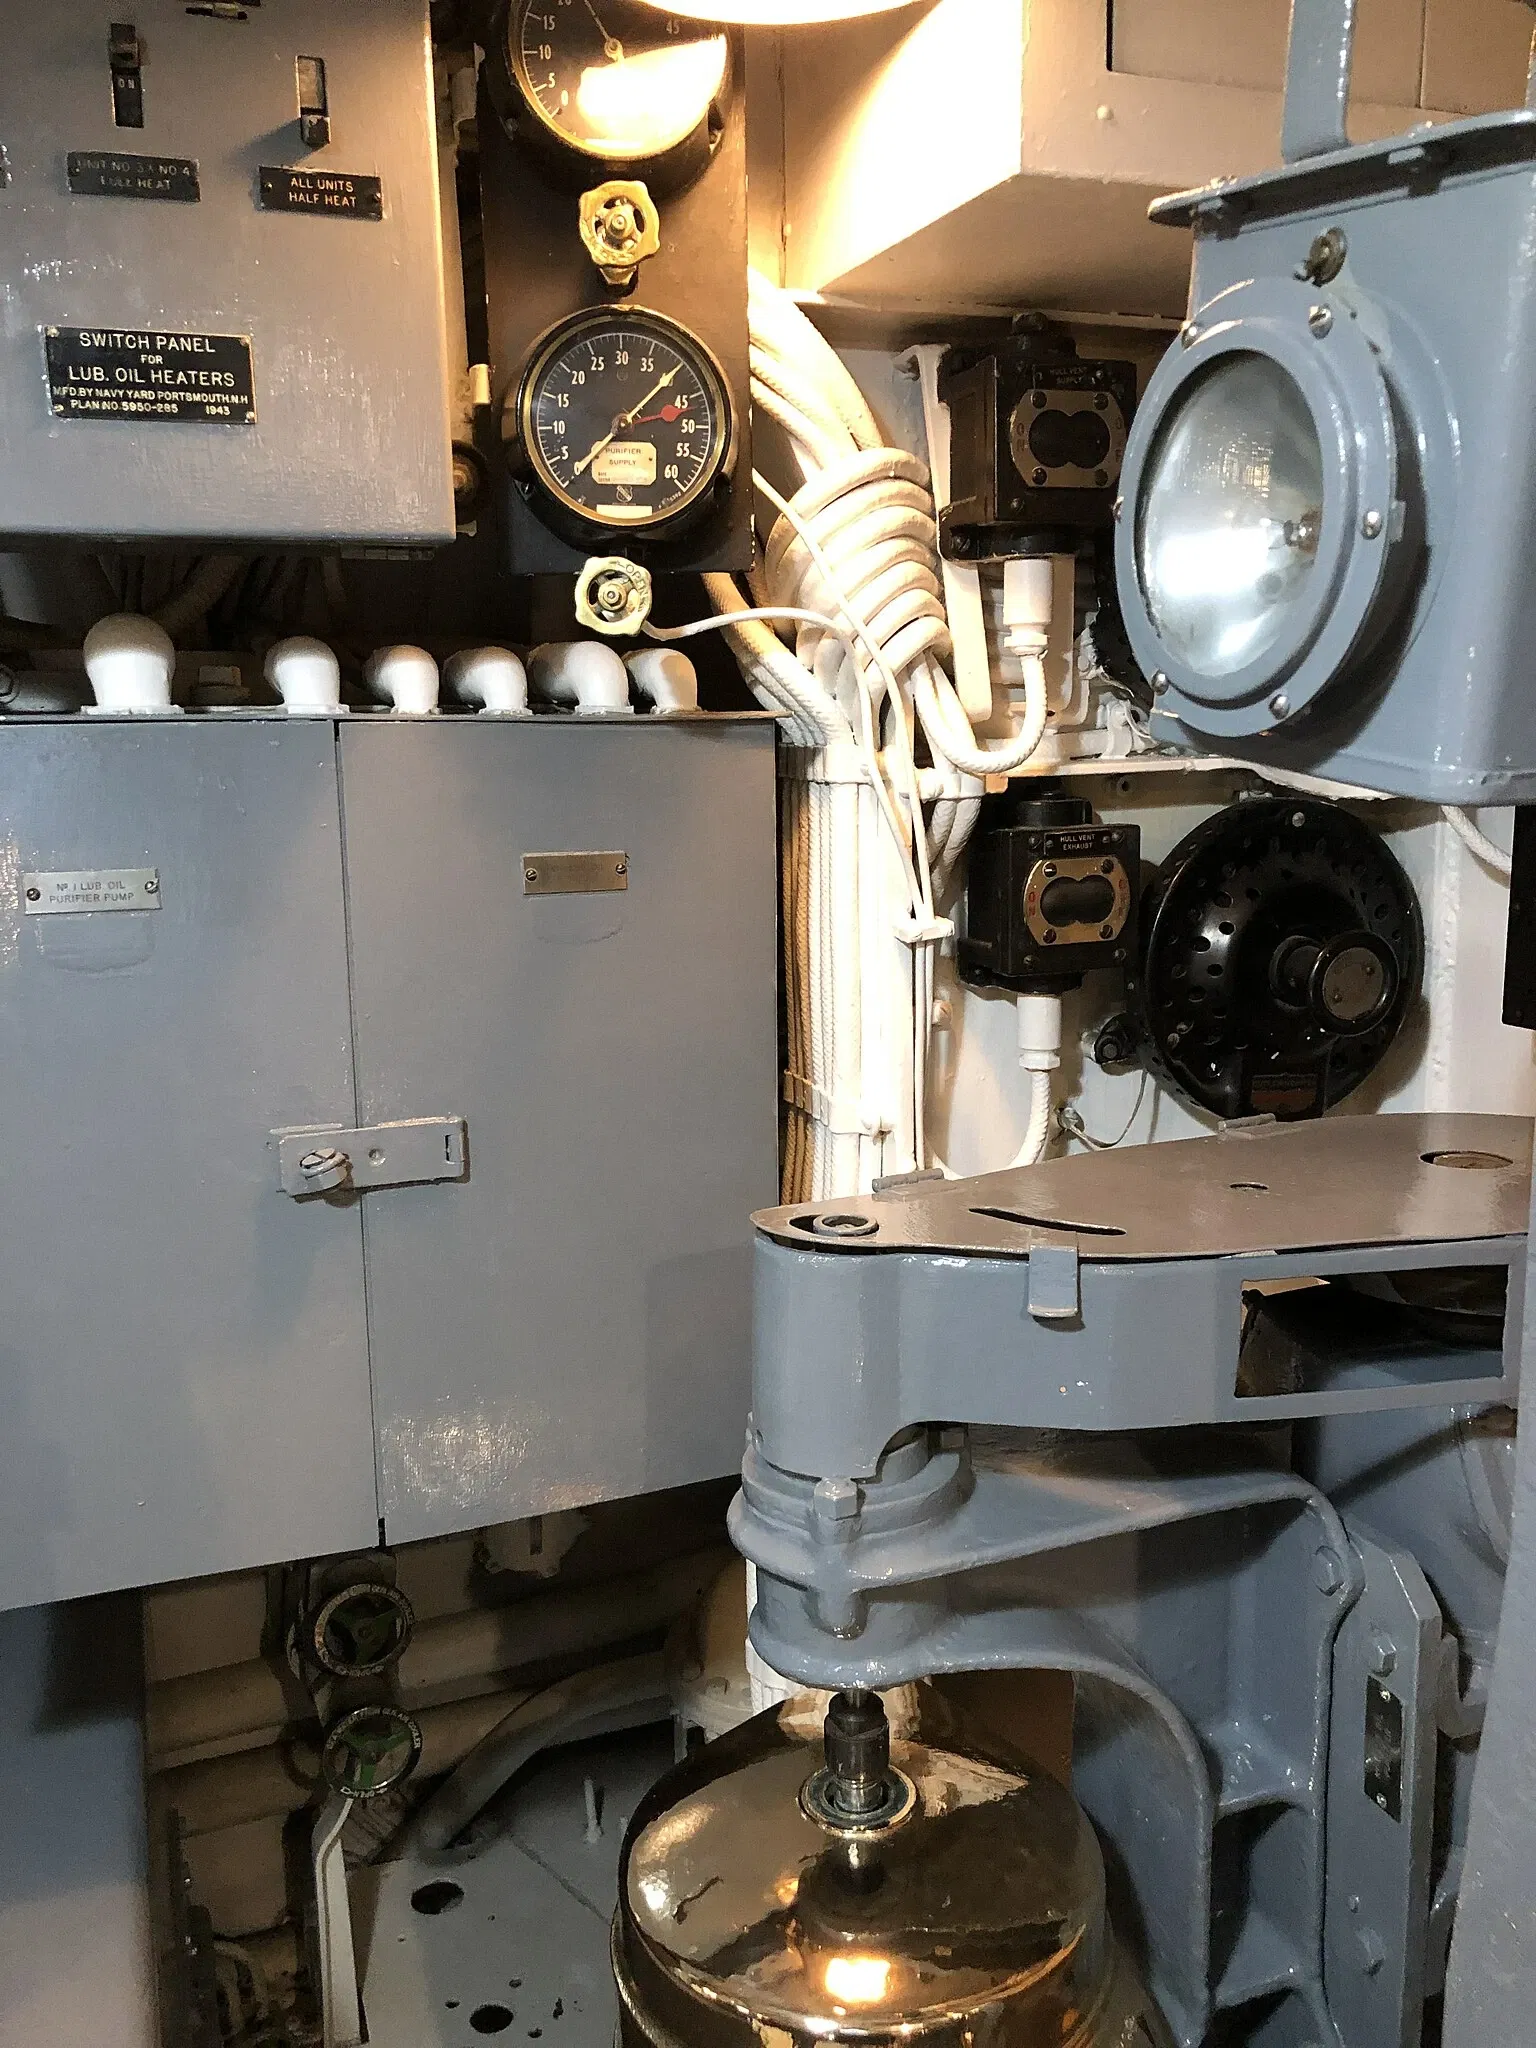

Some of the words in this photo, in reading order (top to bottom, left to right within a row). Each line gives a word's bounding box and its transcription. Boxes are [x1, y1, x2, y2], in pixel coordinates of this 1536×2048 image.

[543, 15, 555, 31] 15
[666, 21, 680, 35] 45
[539, 45, 551, 60] 10
[118, 77, 135, 89] ON
[548, 73, 556, 88] 5
[561, 90, 569, 106] 0
[160, 165, 177, 176] NO
[138, 179, 171, 190] HEAT
[291, 177, 313, 189] ALL
[317, 179, 354, 193] UNITS
[289, 192, 319, 204] HALF
[325, 194, 356, 207] HEAT
[80, 333, 150, 349] SWITCH
[156, 336, 216, 352] PANEL
[140, 355, 163, 364] FOR
[591, 357, 605, 371] 25
[615, 351, 629, 365] 30
[640, 358, 654, 372] 35
[68, 366, 110, 381] LUB.
[115, 368, 145, 383] OIL
[151, 370, 235, 387] HEATERS
[571, 371, 585, 385] 20
[95, 388, 124, 398] NAVY
[126, 390, 155, 400] YARD
[557, 393, 570, 408] 15
[70, 400, 99, 410] PLAN
[205, 405, 230, 415] 1943
[675, 395, 689, 409] 45
[553, 420, 566, 435] 10
[681, 419, 695, 434] 50
[561, 446, 569, 461] 5
[676, 443, 690, 458] 55
[664, 464, 679, 480] 60
[1060, 835, 1077, 843] HULL
[1063, 842, 1093, 851] EXHAUST
[80, 882, 102, 891] LUB
[107, 881, 126, 889] OIL
[49, 894, 100, 904] PURIFIER
[104, 892, 135, 902] PUMP
